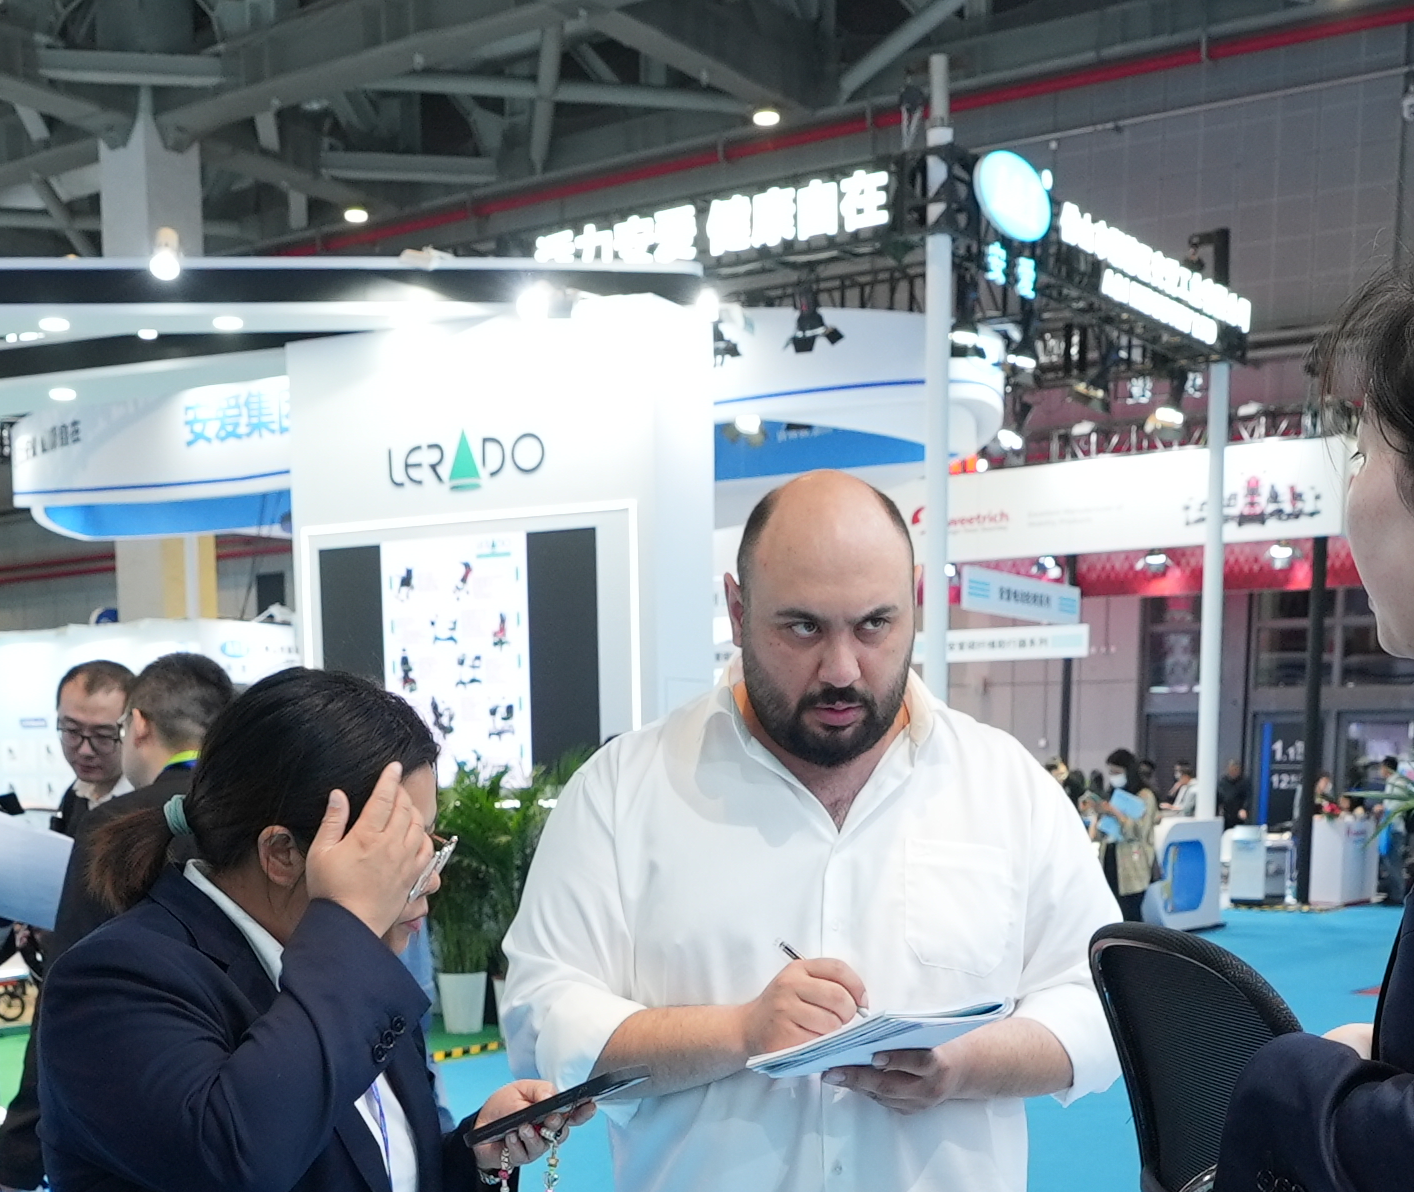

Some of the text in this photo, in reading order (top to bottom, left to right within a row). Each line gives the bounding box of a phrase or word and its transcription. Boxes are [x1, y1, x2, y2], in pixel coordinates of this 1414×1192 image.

[184, 391, 290, 447] 安爱集
[389, 429, 544, 489] LERADO
